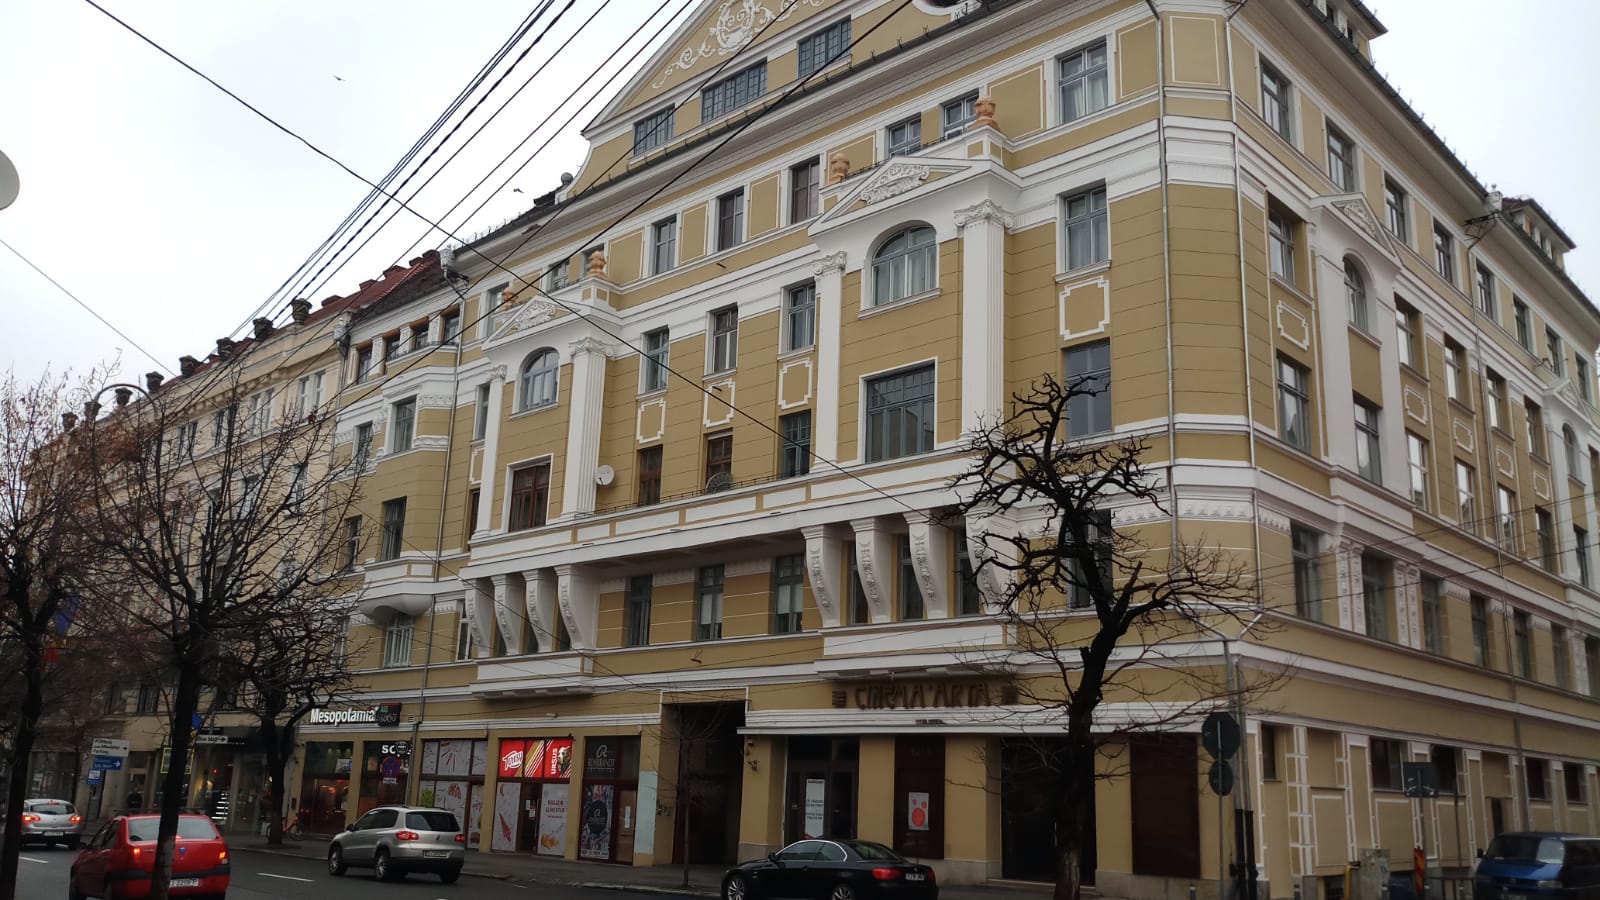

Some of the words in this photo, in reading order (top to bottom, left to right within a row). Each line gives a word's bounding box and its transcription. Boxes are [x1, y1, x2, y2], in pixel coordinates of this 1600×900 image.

[855, 685, 924, 710] CINEMA
[932, 681, 991, 707] ARTA
[310, 708, 376, 726] Mesopotamia
